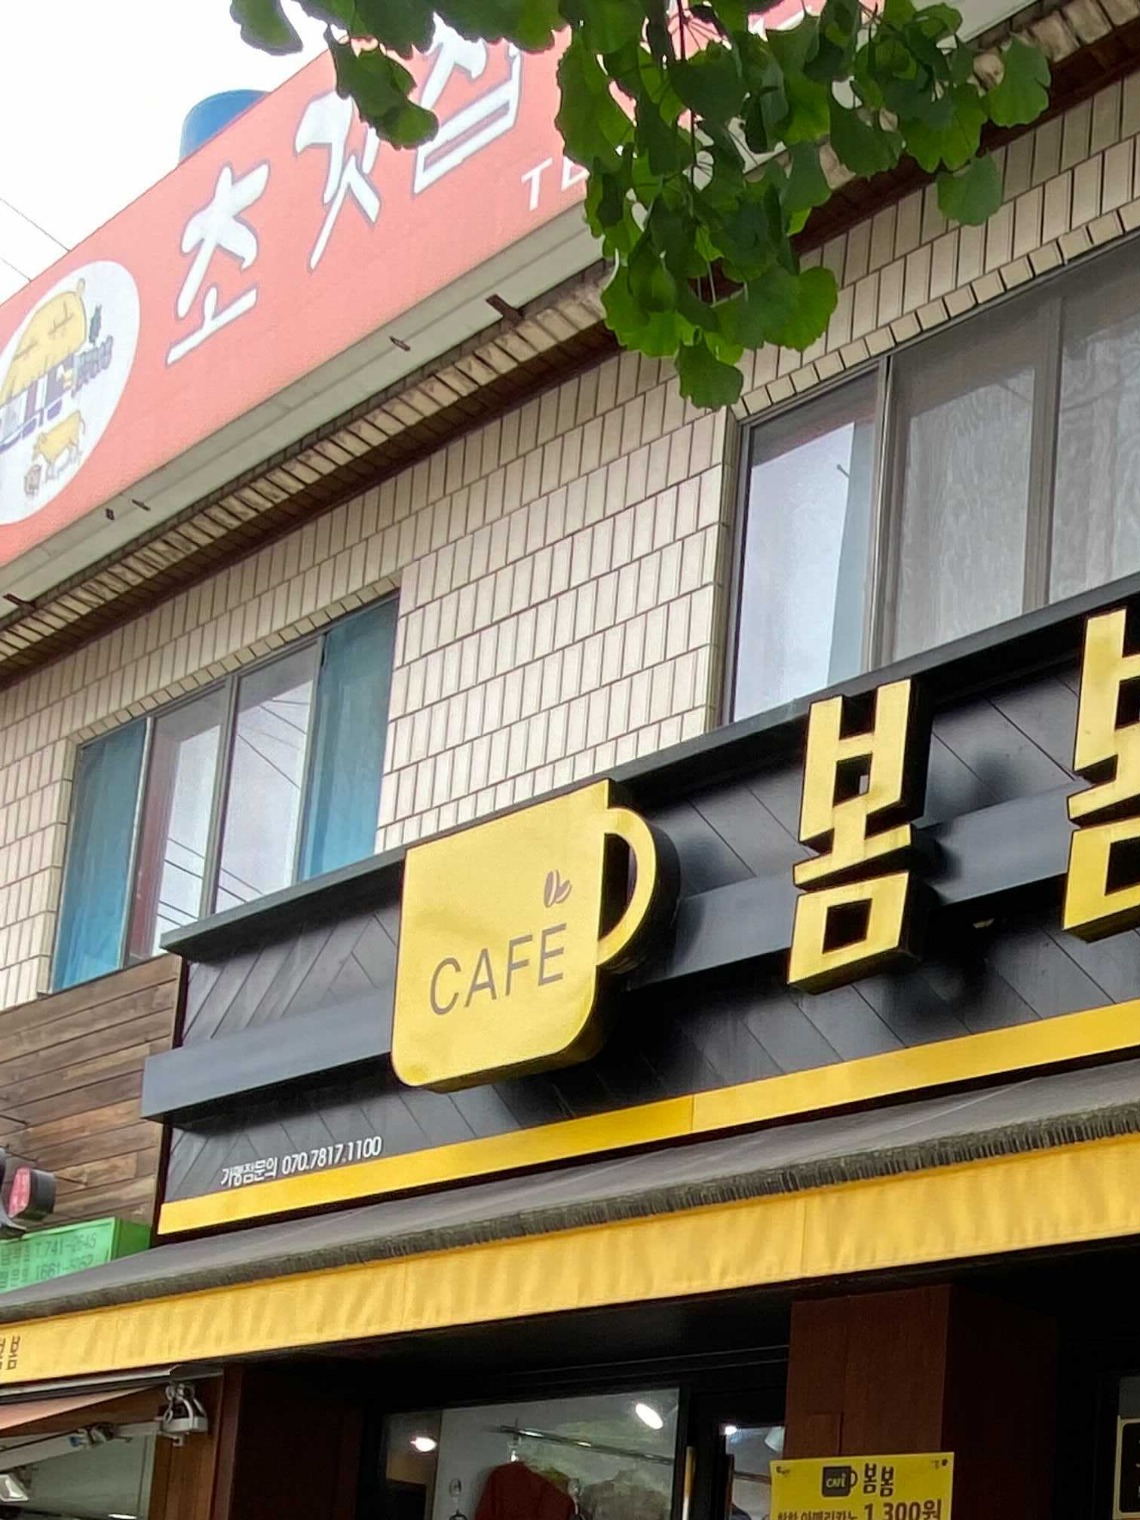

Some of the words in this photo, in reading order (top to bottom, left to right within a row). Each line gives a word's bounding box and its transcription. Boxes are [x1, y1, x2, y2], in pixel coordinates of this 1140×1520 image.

[429, 922, 566, 1016] CAFE
[220, 1157, 278, 1187] 가맹점문의
[281, 1136, 382, 1175] 070.7817.1100
[863, 1463, 894, 1497] 봄봄
